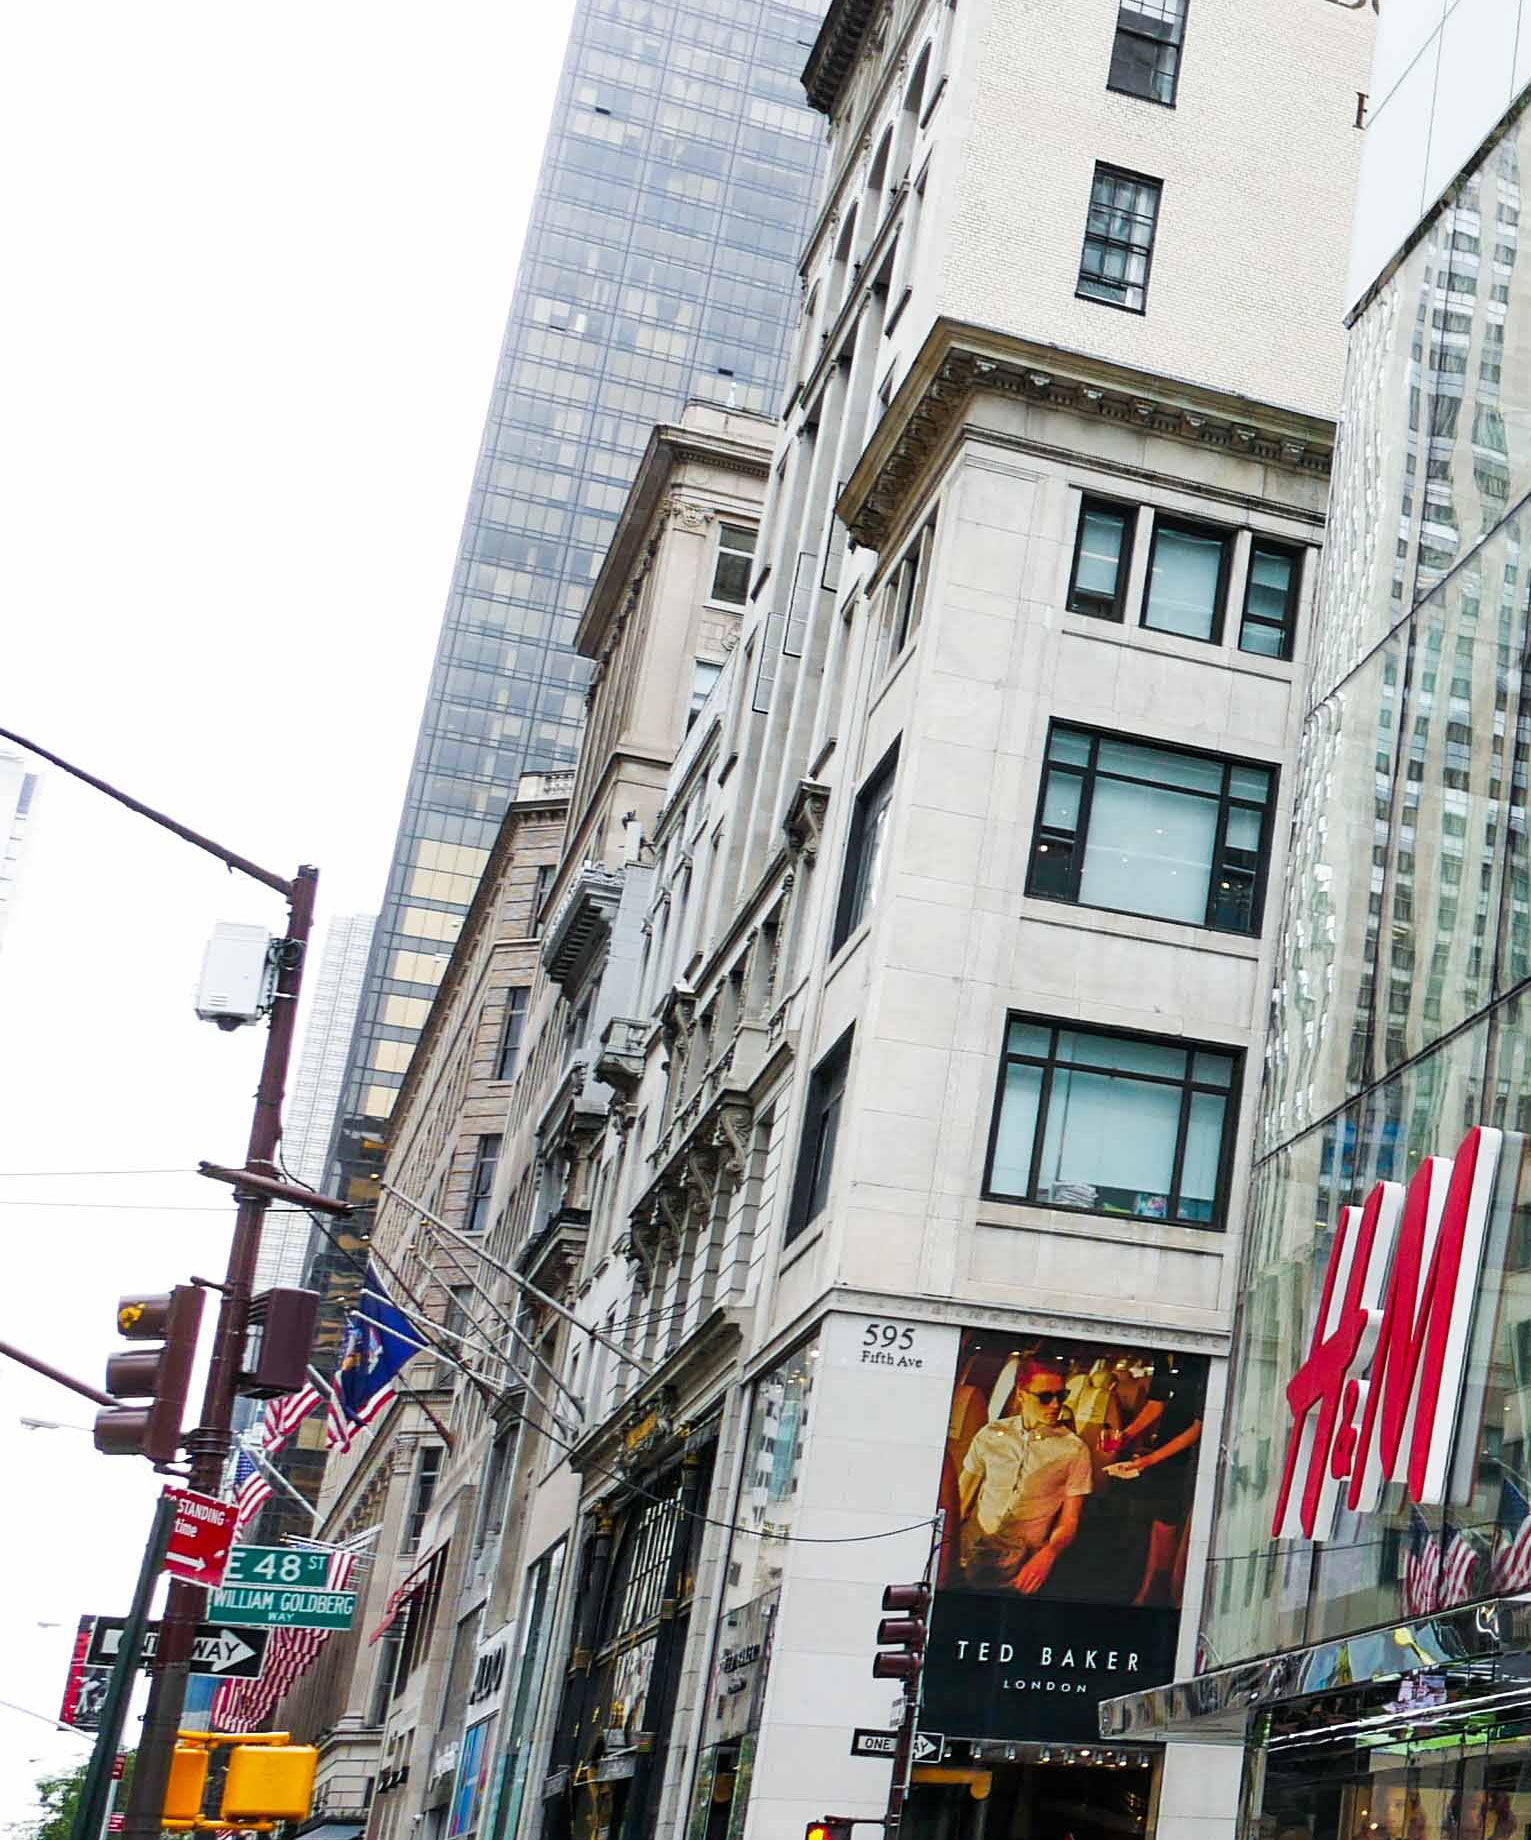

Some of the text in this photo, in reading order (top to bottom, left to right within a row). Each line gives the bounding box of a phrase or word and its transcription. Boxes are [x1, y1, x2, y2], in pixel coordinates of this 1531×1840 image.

[863, 1324, 915, 1350] 595
[1272, 1125, 1501, 1540] H&M
[861, 1350, 923, 1368] Fifth Ave
[177, 1499, 225, 1526] STANDING
[174, 1518, 198, 1538] time
[227, 1551, 327, 1582] E 48 ST
[214, 1590, 354, 1615] WILLIAM GOLDBERG
[268, 1612, 295, 1622] WAY
[957, 1640, 1140, 1672] TED BAKER
[1003, 1680, 1087, 1693] LONDON
[865, 1738, 929, 1754] ONE AY
